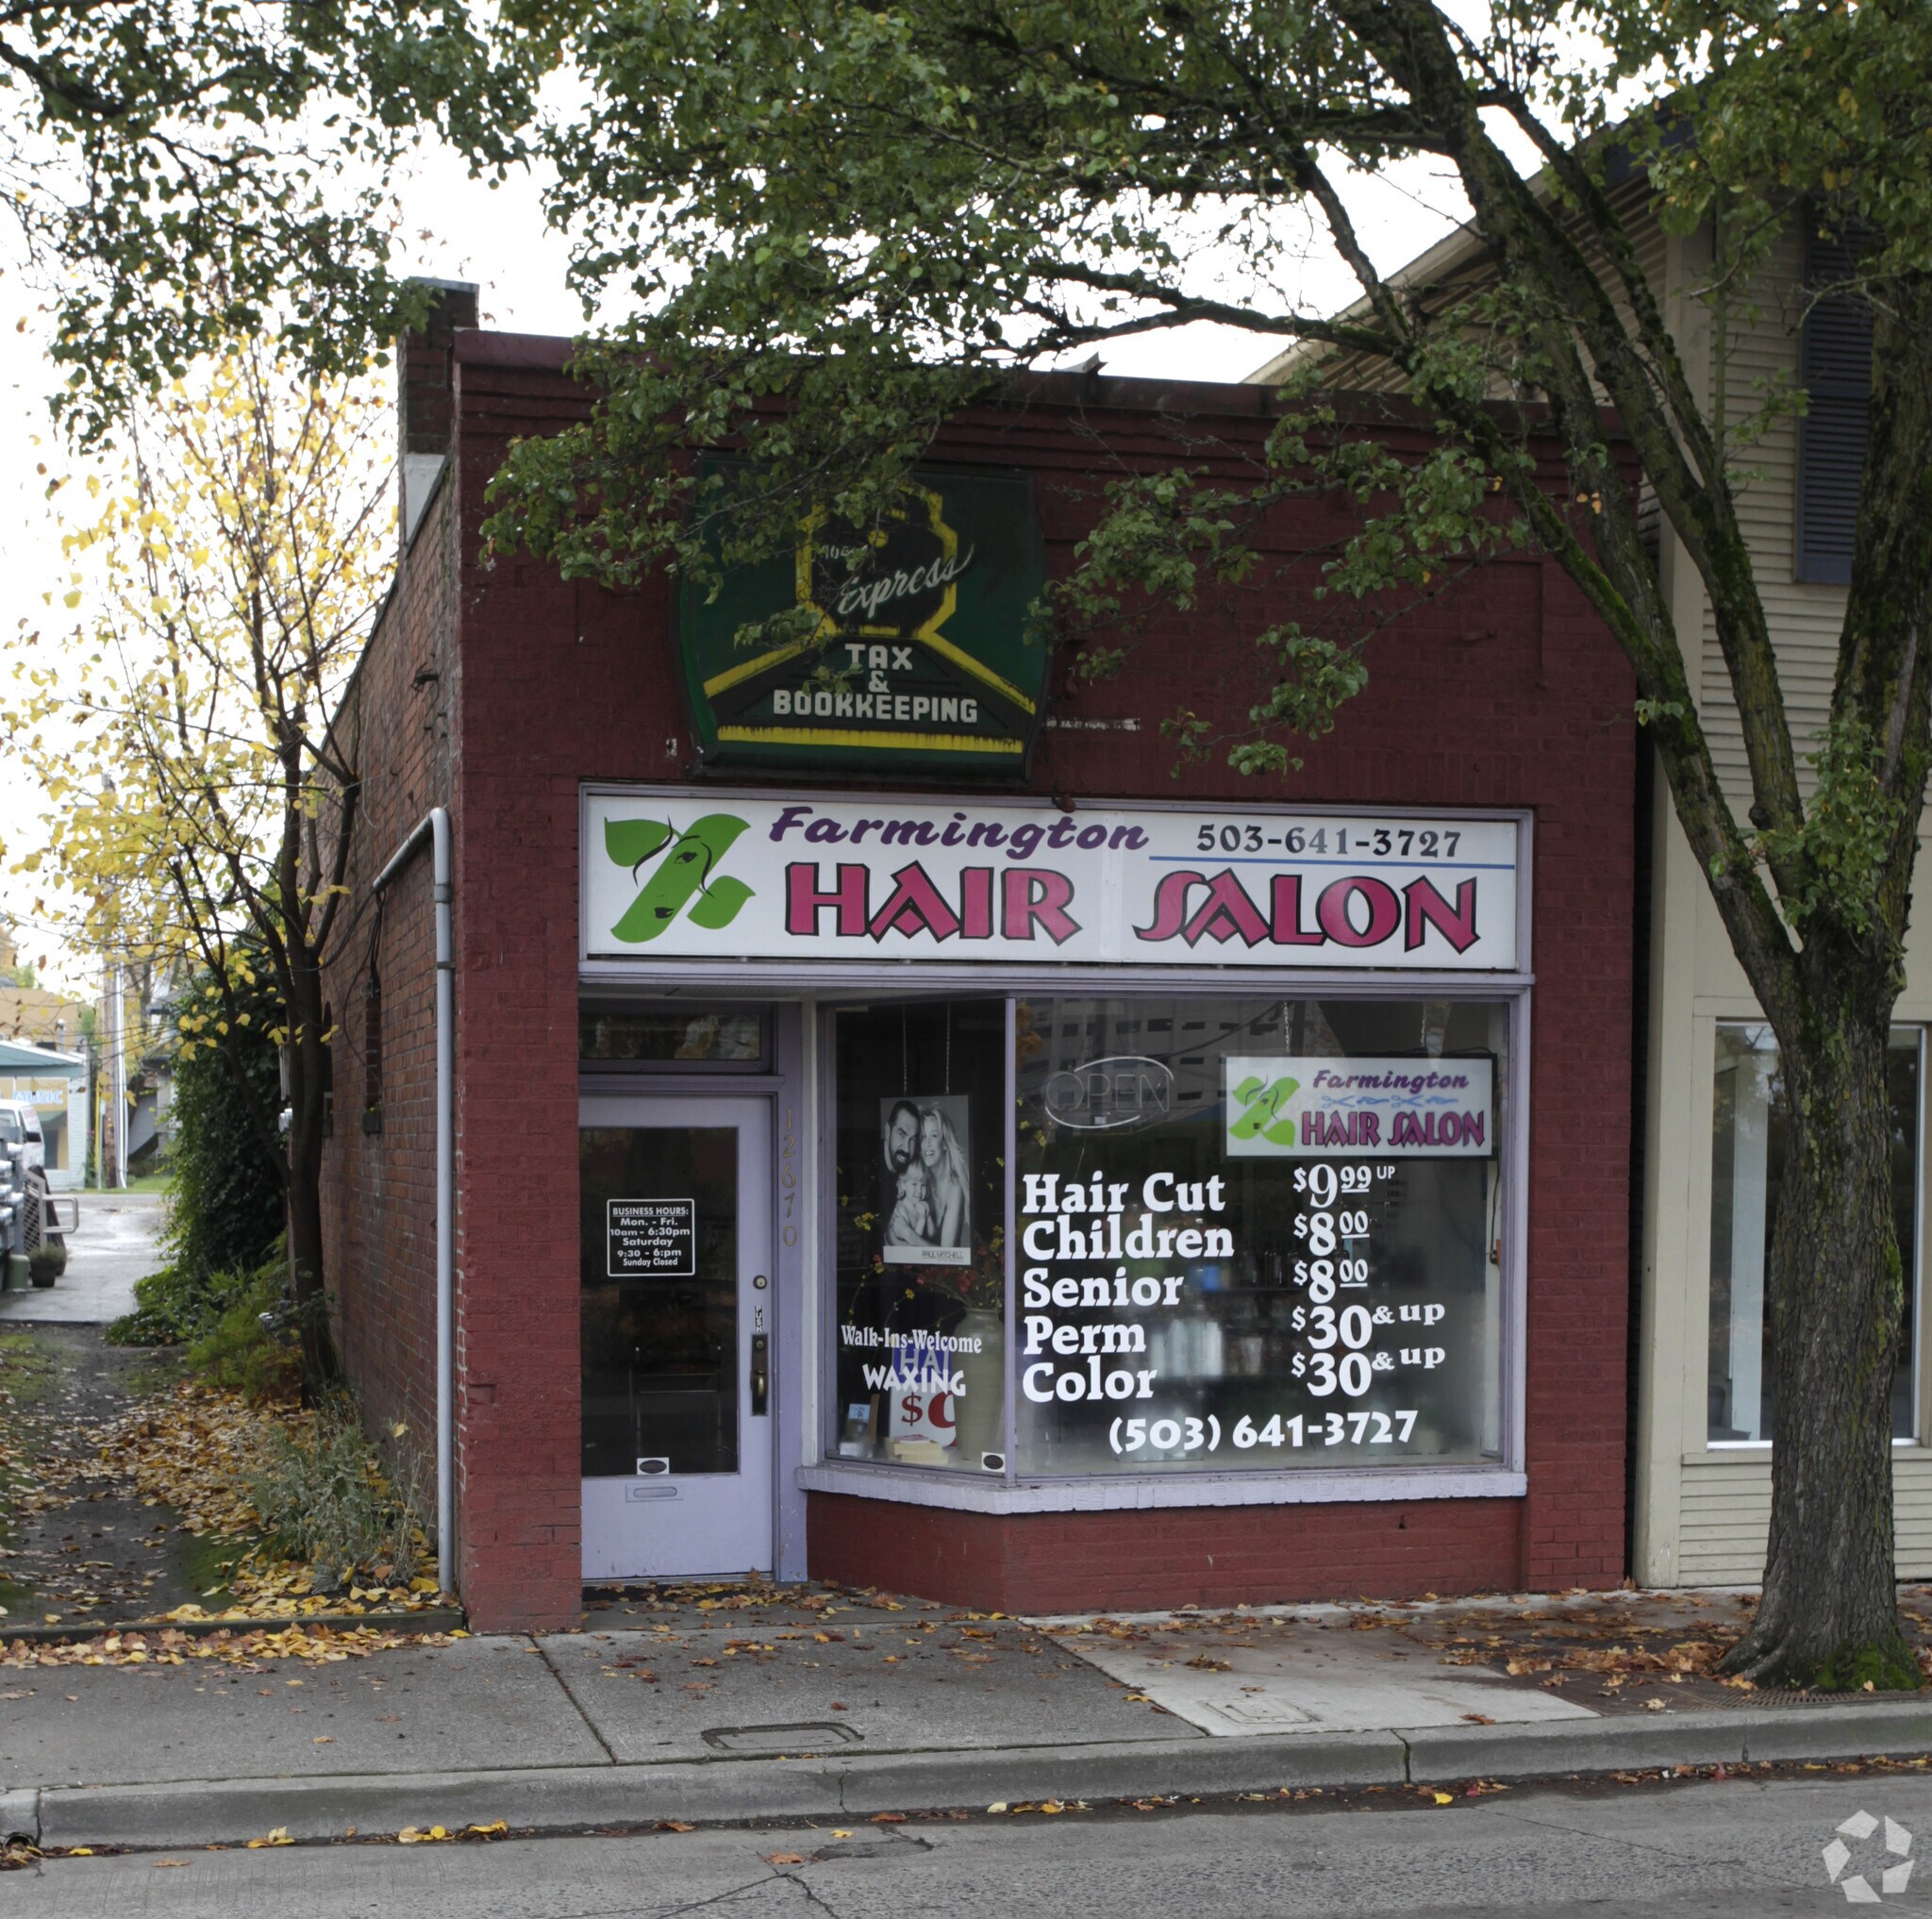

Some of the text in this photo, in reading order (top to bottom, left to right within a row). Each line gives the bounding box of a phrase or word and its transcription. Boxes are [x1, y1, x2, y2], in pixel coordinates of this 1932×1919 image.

[838, 542, 974, 619] Express
[844, 643, 912, 670] TAX
[868, 670, 890, 693] &
[773, 690, 978, 724] BOOKKEEPING
[769, 806, 1150, 860] Farmington
[1196, 824, 1462, 858] 503-641-3727
[784, 859, 1481, 955] HAIR SALON
[1046, 1070, 1170, 1114] OPEN
[1312, 1069, 1470, 1094] Farmington
[1301, 1110, 1485, 1148] HAIR SALON
[1376, 1165, 1396, 1179] UP
[1022, 1170, 1226, 1213] Hair Cut
[612, 1207, 689, 1216] BUSINESS HOURS:
[660, 1217, 678, 1226] Fri.
[623, 1237, 674, 1247] Saturday
[647, 1227, 691, 1237] 6:30pm
[1023, 1212, 1235, 1260] Children
[623, 1258, 678, 1268] Sunday Closed
[1023, 1266, 1184, 1309] Senior
[1023, 1315, 1147, 1355] Perm
[1291, 1305, 1373, 1350] $30
[1399, 1303, 1445, 1326] up
[862, 1363, 966, 1396] WAXING
[1023, 1355, 1158, 1403] Color
[1291, 1352, 1373, 1396] $30
[1399, 1346, 1446, 1369] up
[1108, 1410, 1418, 1455] (503) 641-3727
